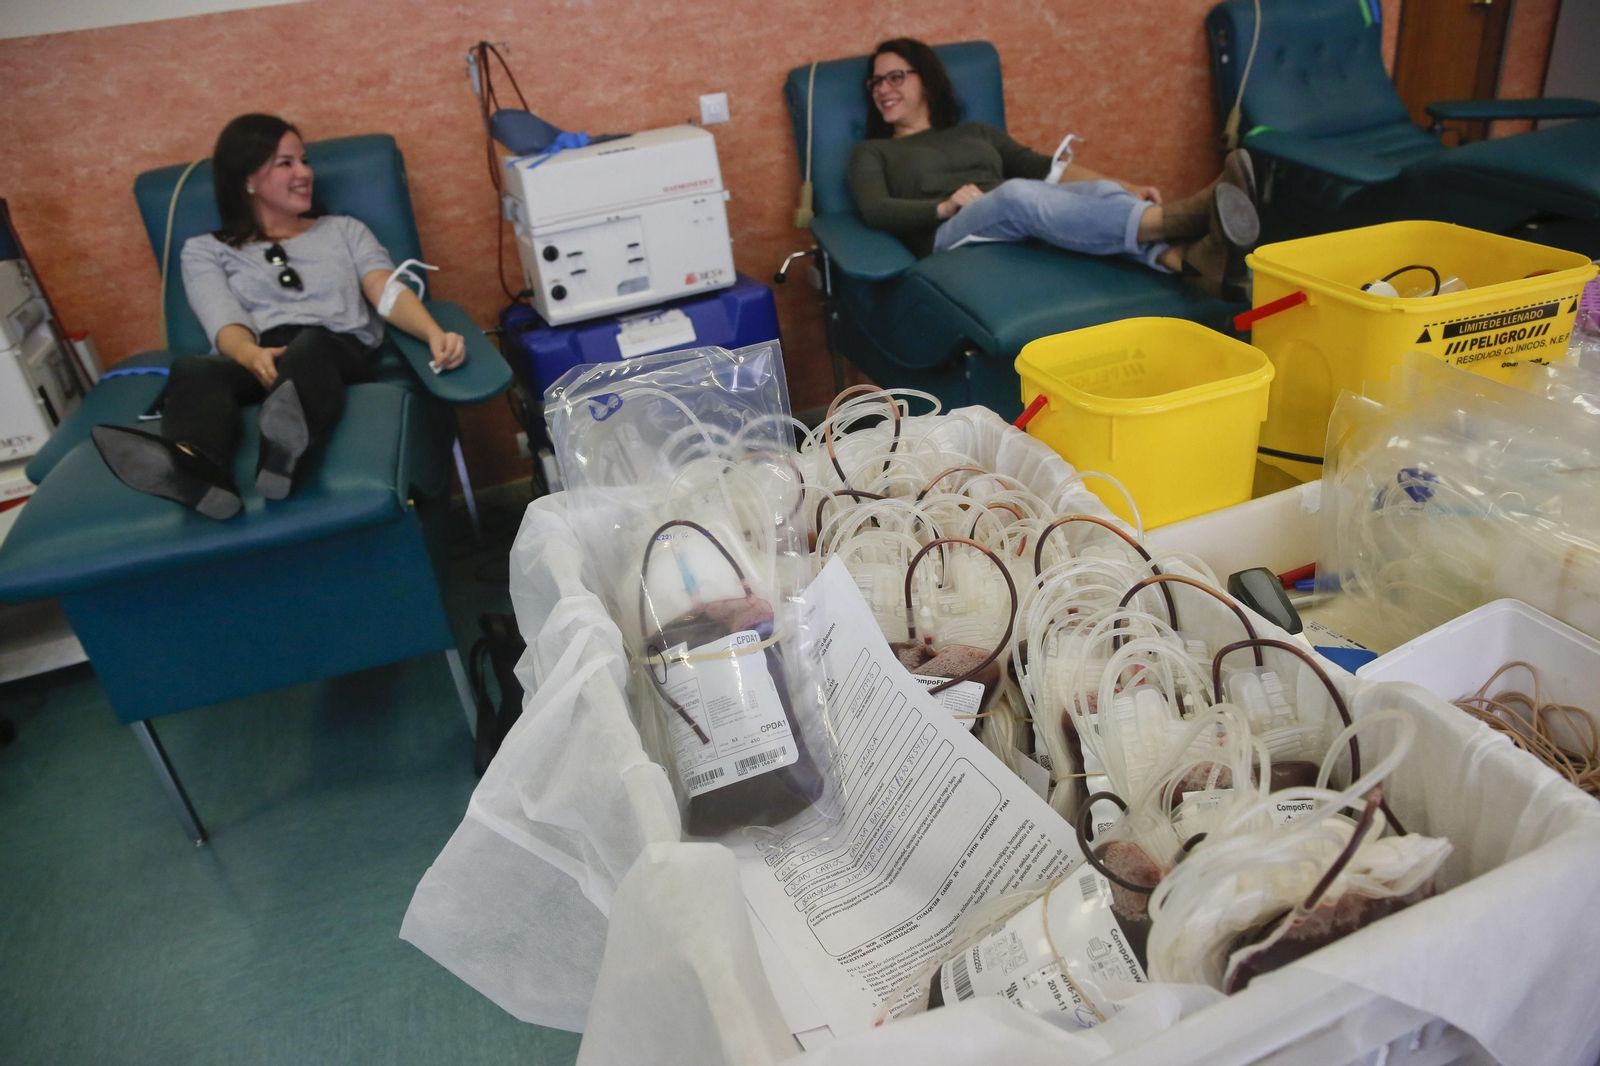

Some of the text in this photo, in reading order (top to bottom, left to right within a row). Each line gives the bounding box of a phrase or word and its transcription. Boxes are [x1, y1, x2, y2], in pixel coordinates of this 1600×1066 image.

[1459, 309, 1544, 334] LÍMITE DE LLENADO
[1456, 349, 1502, 365] RESIDUOS
[1503, 339, 1548, 356] CLÍNICOS,
[736, 632, 758, 645] CPDA1
[759, 719, 786, 733] CPDA1
[837, 947, 862, 962] ROGAMOS
[865, 940, 876, 948] NOS
[915, 897, 941, 921] CUALQUIER
[939, 878, 953, 896] CAMBIO
[952, 869, 959, 877] EN
[958, 858, 967, 868] LOS
[966, 841, 979, 857] DATOS
[978, 813, 1000, 840] APORTADOS
[998, 798, 1010, 812] PARA
[1109, 927, 1143, 984] CompoFlow
[1046, 979, 1067, 1011] 2018-11
